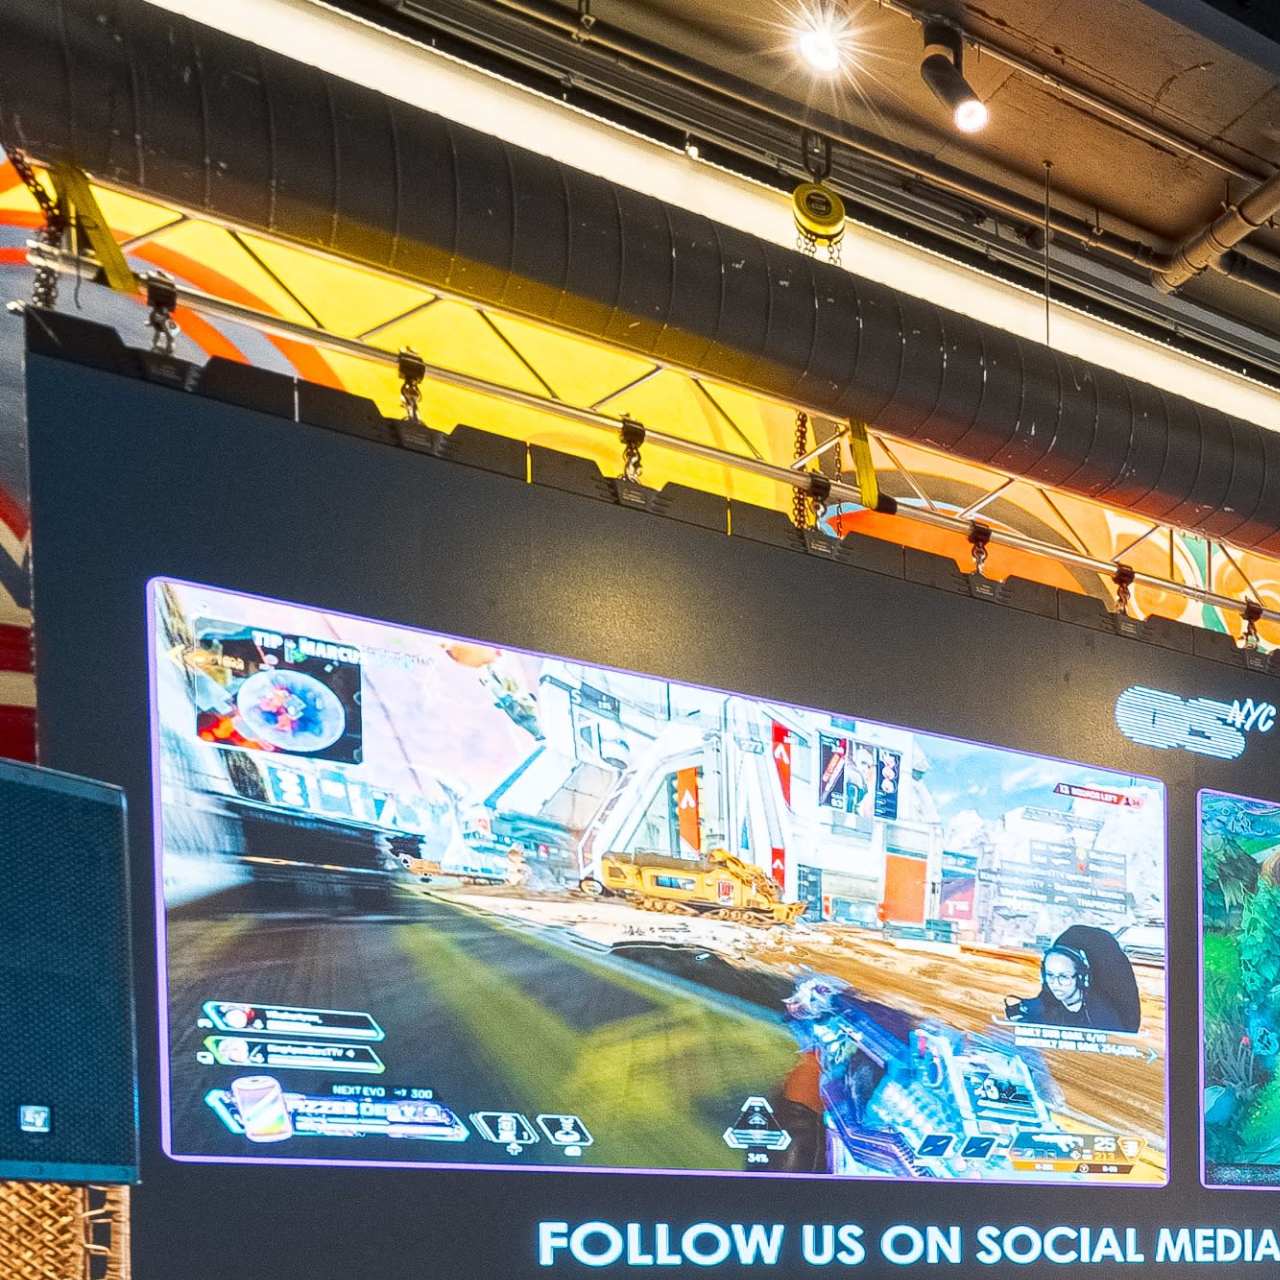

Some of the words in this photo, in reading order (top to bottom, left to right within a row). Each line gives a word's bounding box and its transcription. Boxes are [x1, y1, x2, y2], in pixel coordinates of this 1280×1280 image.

[1227, 697, 1277, 732] NYC
[332, 1084, 360, 1095] NEXT
[363, 1086, 386, 1097] EVO
[539, 1221, 785, 1267] FOLLOW
[803, 1224, 866, 1265] US
[881, 1225, 962, 1265] ON
[976, 1226, 1145, 1265] SOCIAL
